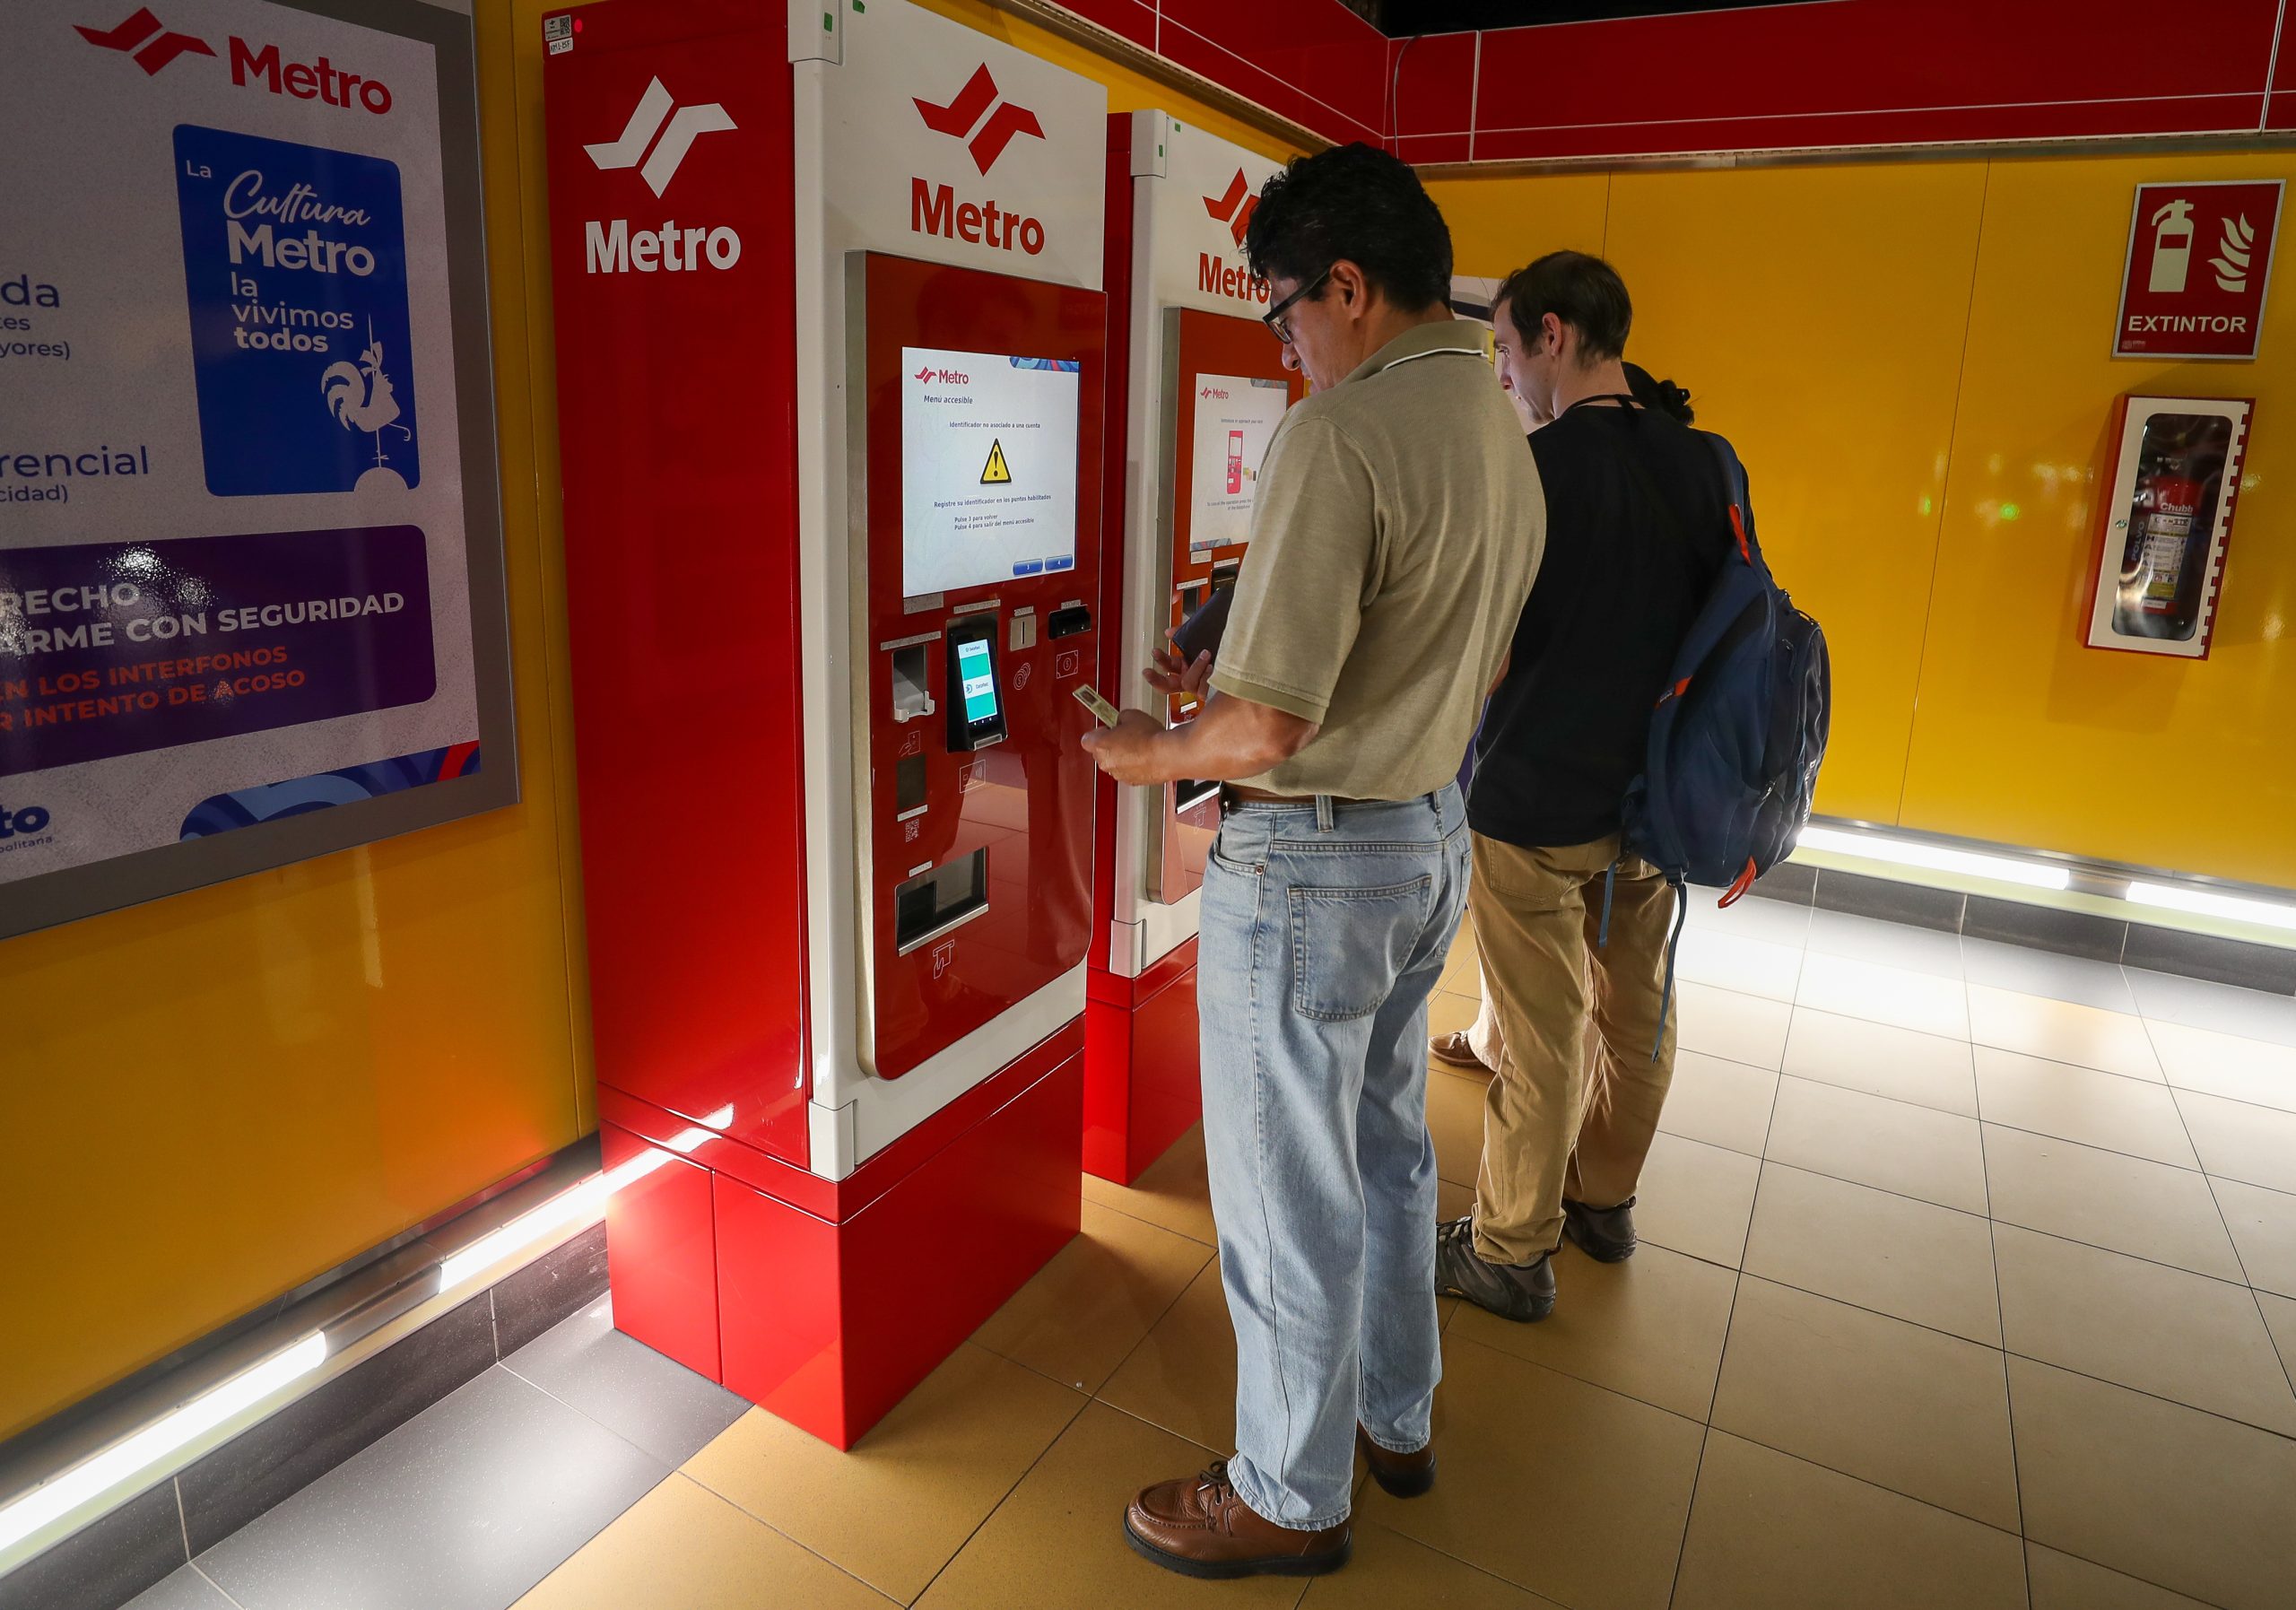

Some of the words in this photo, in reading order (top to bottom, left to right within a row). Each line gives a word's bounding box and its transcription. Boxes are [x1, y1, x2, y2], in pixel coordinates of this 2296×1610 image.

[228, 36, 393, 115] Metro
[187, 160, 212, 178] La
[224, 170, 370, 226] Cultura
[911, 177, 1046, 256] Metro
[227, 220, 375, 276] Metro
[585, 219, 742, 274] Metro
[0, 274, 60, 308] da
[230, 271, 258, 297] la
[1198, 252, 1270, 304] Metro
[231, 299, 354, 329] vivimos
[2127, 315, 2247, 333] EXTINTOR
[0, 341, 70, 361] yores)
[233, 326, 328, 352] todos
[938, 370, 970, 384] Metro
[923, 395, 943, 403] Menú
[944, 396, 973, 405] accesible
[1213, 388, 1229, 400] Metro
[949, 421, 982, 429] Identificador
[990, 422, 1012, 430] asociado
[0, 445, 149, 478] rencial
[934, 500, 956, 509] Registre
[964, 498, 996, 506] identificador
[2160, 502, 2194, 513] Chubb
[0, 582, 141, 617] RECHO
[126, 613, 207, 642] CON
[219, 592, 404, 632] SEGURIDAD
[39, 670, 100, 696] LOS
[109, 646, 288, 686] INTERFONOS
[24, 691, 160, 728] INTENTO
[168, 684, 207, 705] DE
[213, 669, 306, 701] ACOSO
